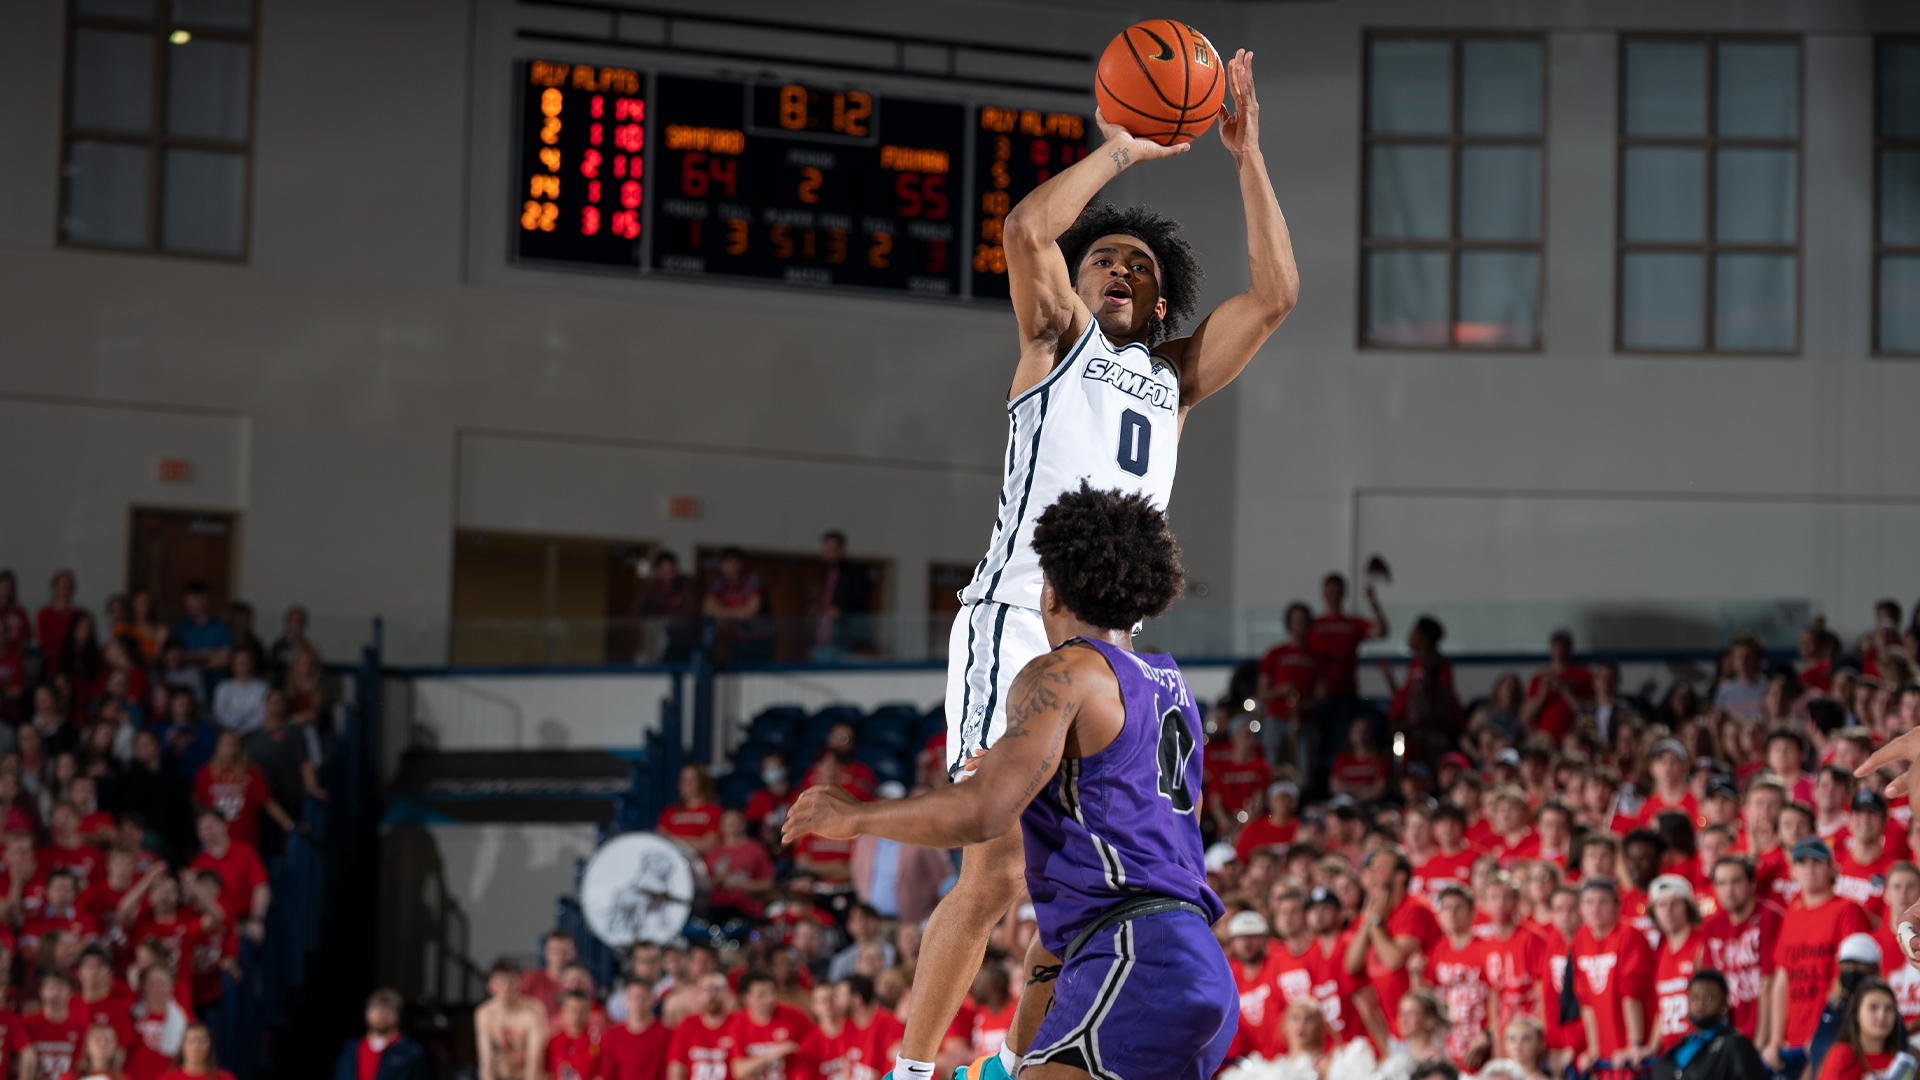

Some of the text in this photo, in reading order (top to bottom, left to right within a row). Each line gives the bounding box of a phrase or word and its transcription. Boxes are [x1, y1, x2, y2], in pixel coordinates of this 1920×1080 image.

[590, 94, 604, 119] 1
[779, 84, 872, 137] 8:12
[589, 122, 603, 146] 1
[580, 148, 602, 178] 2
[613, 153, 643, 180] 11
[681, 153, 737, 198] 64
[588, 179, 601, 204] 1
[798, 166, 823, 204] 2
[895, 172, 948, 220] 55
[520, 200, 559, 232] 22
[580, 205, 600, 236] 3
[726, 219, 749, 255] 3
[868, 232, 893, 268] 2
[1114, 406, 1152, 480] 0
